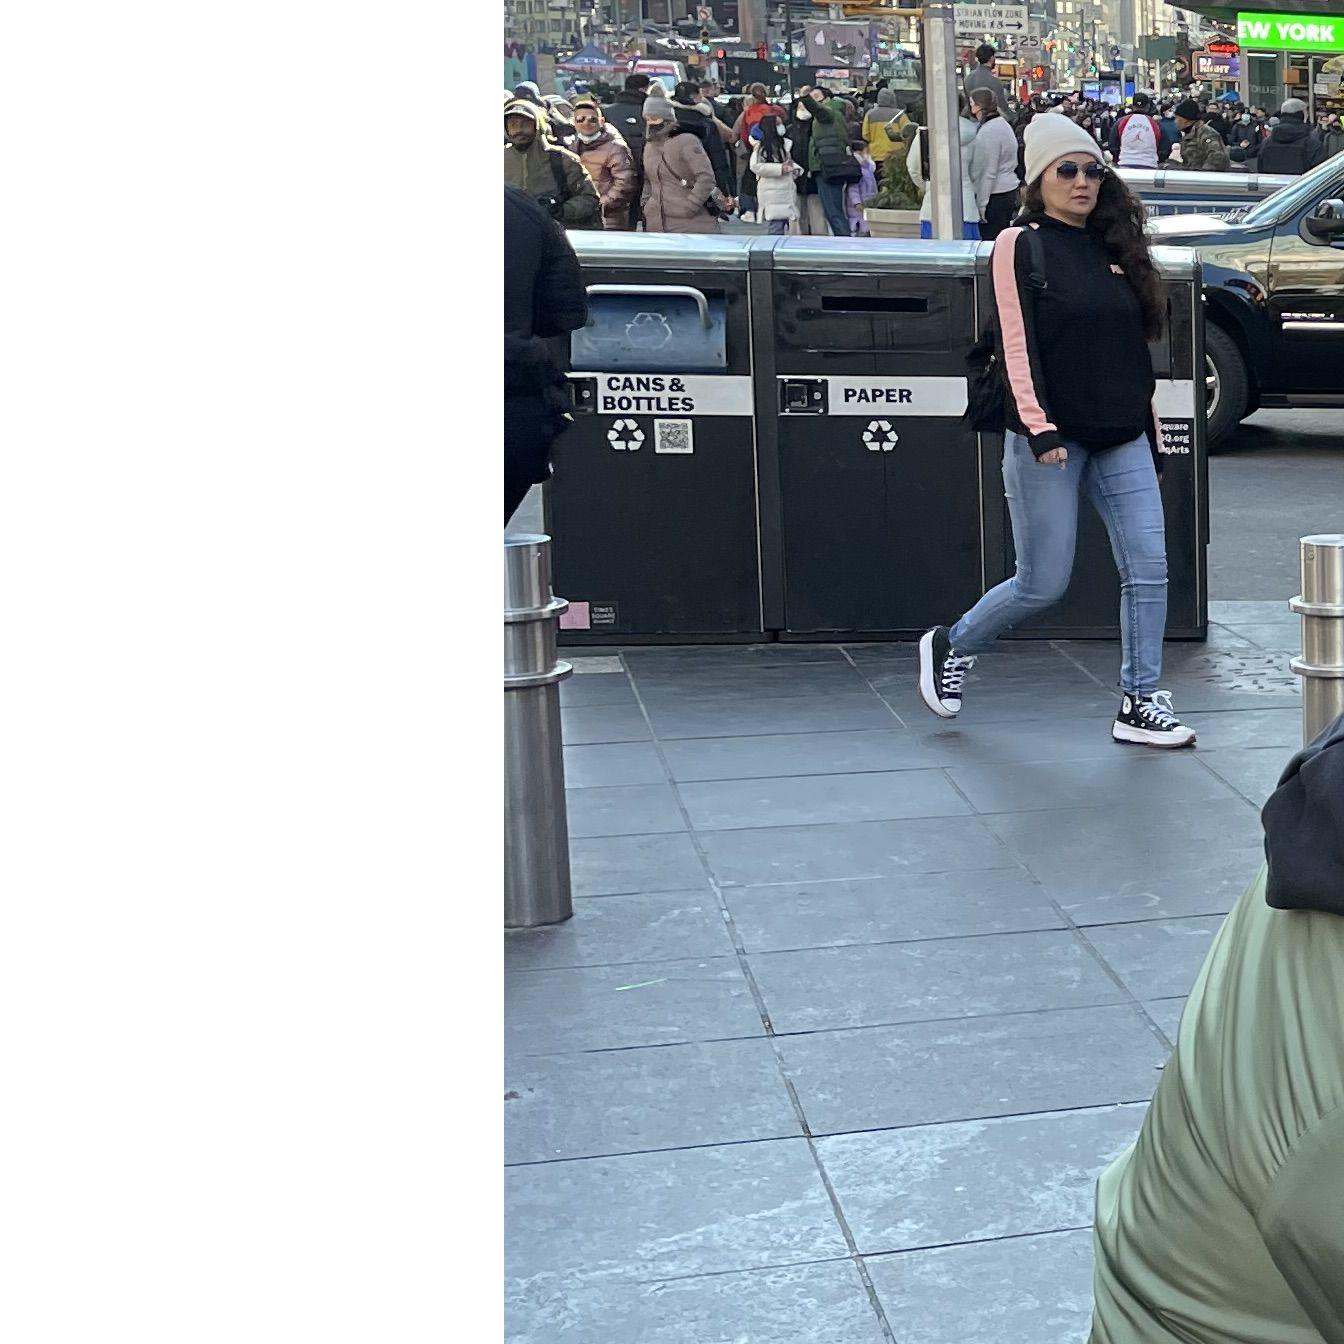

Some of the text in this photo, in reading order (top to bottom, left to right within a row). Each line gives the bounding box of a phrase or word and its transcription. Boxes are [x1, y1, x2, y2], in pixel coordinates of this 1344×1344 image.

[957, 9, 982, 17] STRIAN
[1275, 22, 1336, 43] YORK
[1020, 36, 1039, 47] 25
[607, 376, 686, 393] CANS &
[844, 388, 913, 403] PAPER
[603, 396, 695, 412] BOTTLES
[1161, 423, 1189, 431] quare
[1164, 434, 1190, 444] Q.org
[1164, 446, 1190, 455] qArts
